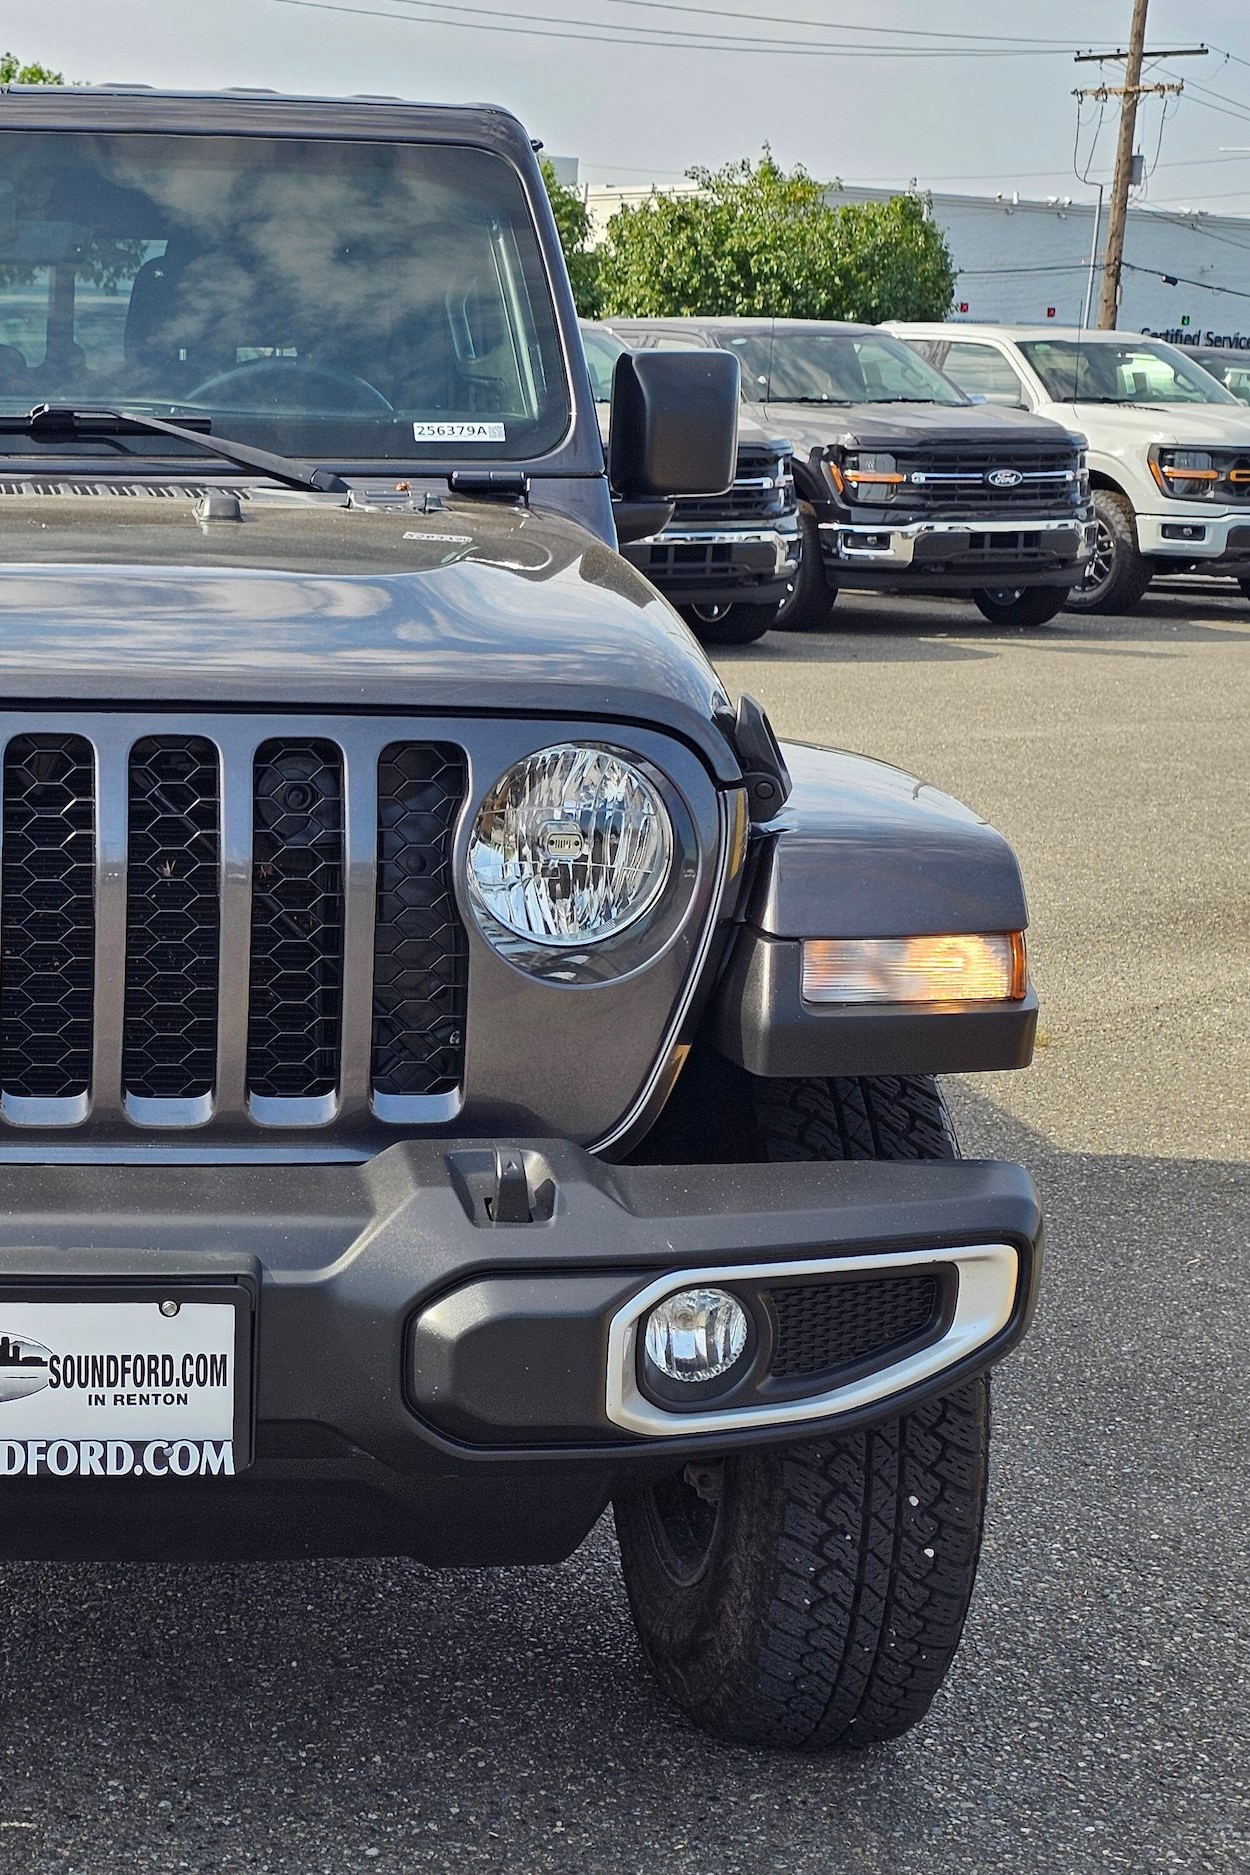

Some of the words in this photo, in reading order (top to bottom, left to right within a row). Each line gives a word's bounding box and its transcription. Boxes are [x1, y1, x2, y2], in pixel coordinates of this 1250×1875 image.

[416, 425, 488, 437] 256379A
[48, 1353, 228, 1389] SOUNDFORD.COM
[88, 1394, 106, 1406] IN
[113, 1393, 188, 1406] RENTON
